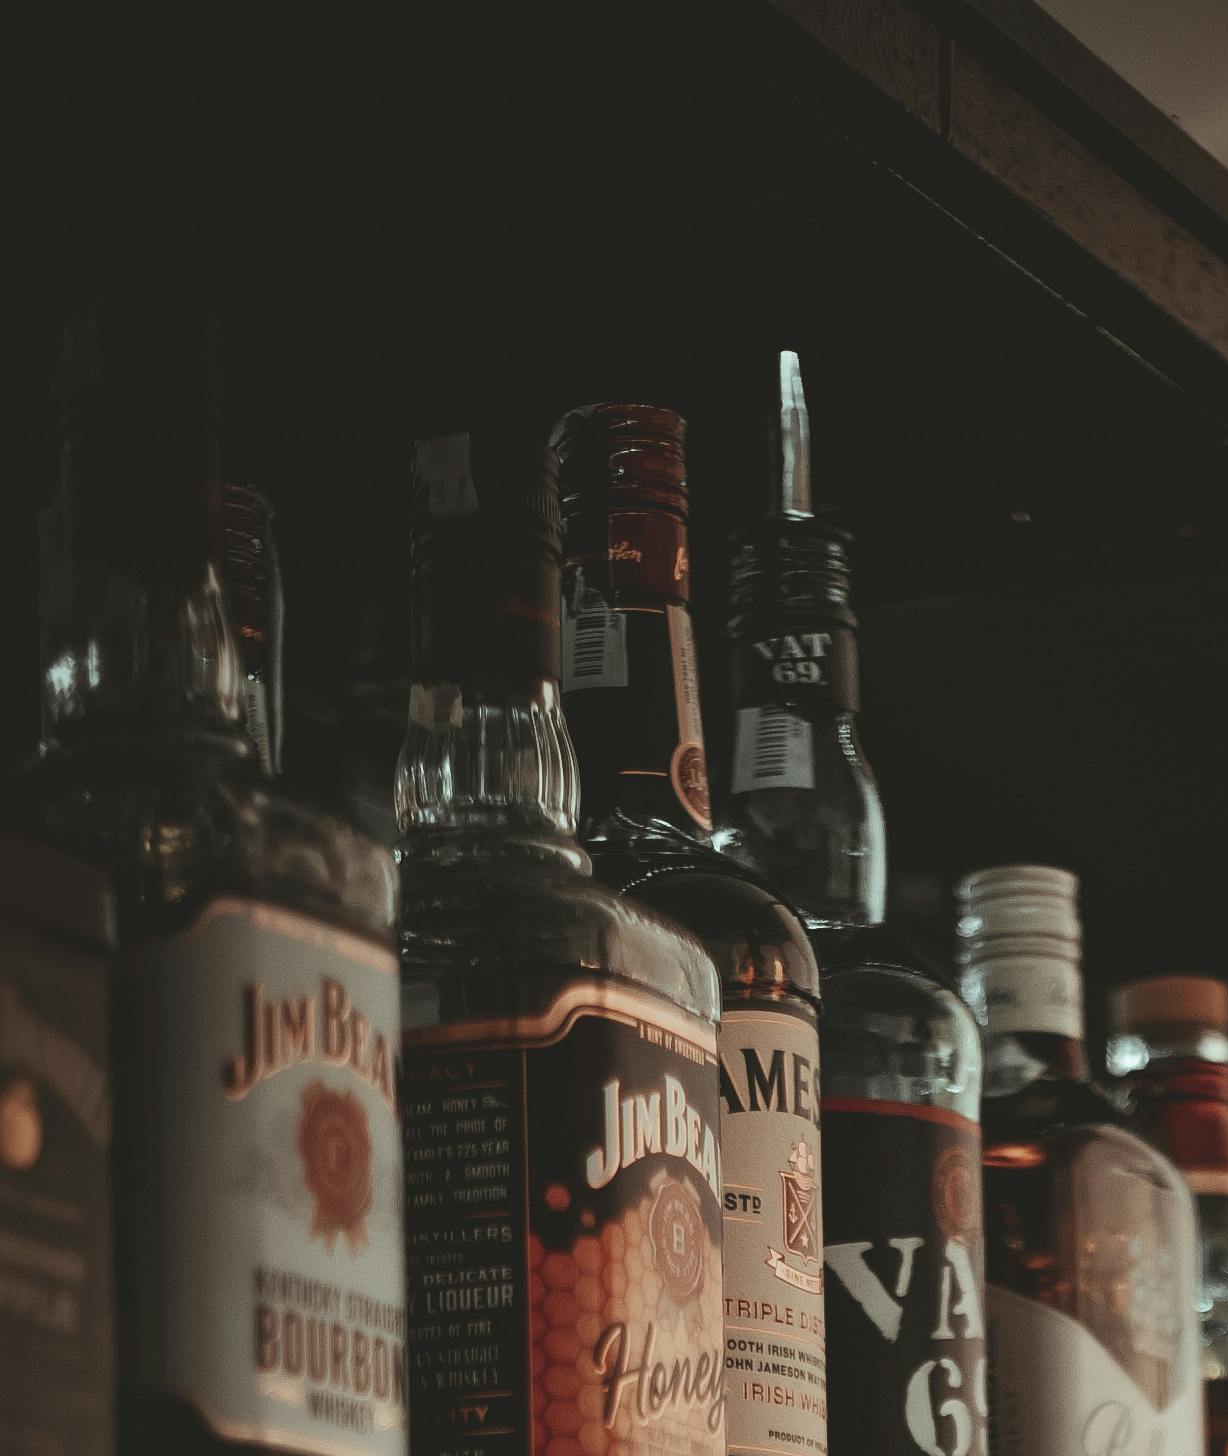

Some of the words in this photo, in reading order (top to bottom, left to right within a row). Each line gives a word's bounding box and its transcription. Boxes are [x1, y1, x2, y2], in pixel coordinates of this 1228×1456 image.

[752, 633, 832, 660] VAT
[322, 974, 400, 1114] BEA
[586, 1078, 662, 1189] JIM
[664, 1074, 721, 1207] BEA
[725, 1298, 794, 1326] TRIPLE
[767, 1343, 796, 1361] IRISH
[593, 1321, 724, 1434] Honey
[757, 1361, 806, 1382] JAMESON
[743, 1382, 796, 1408] IRISH
[768, 1429, 806, 1446] PRODUCT
